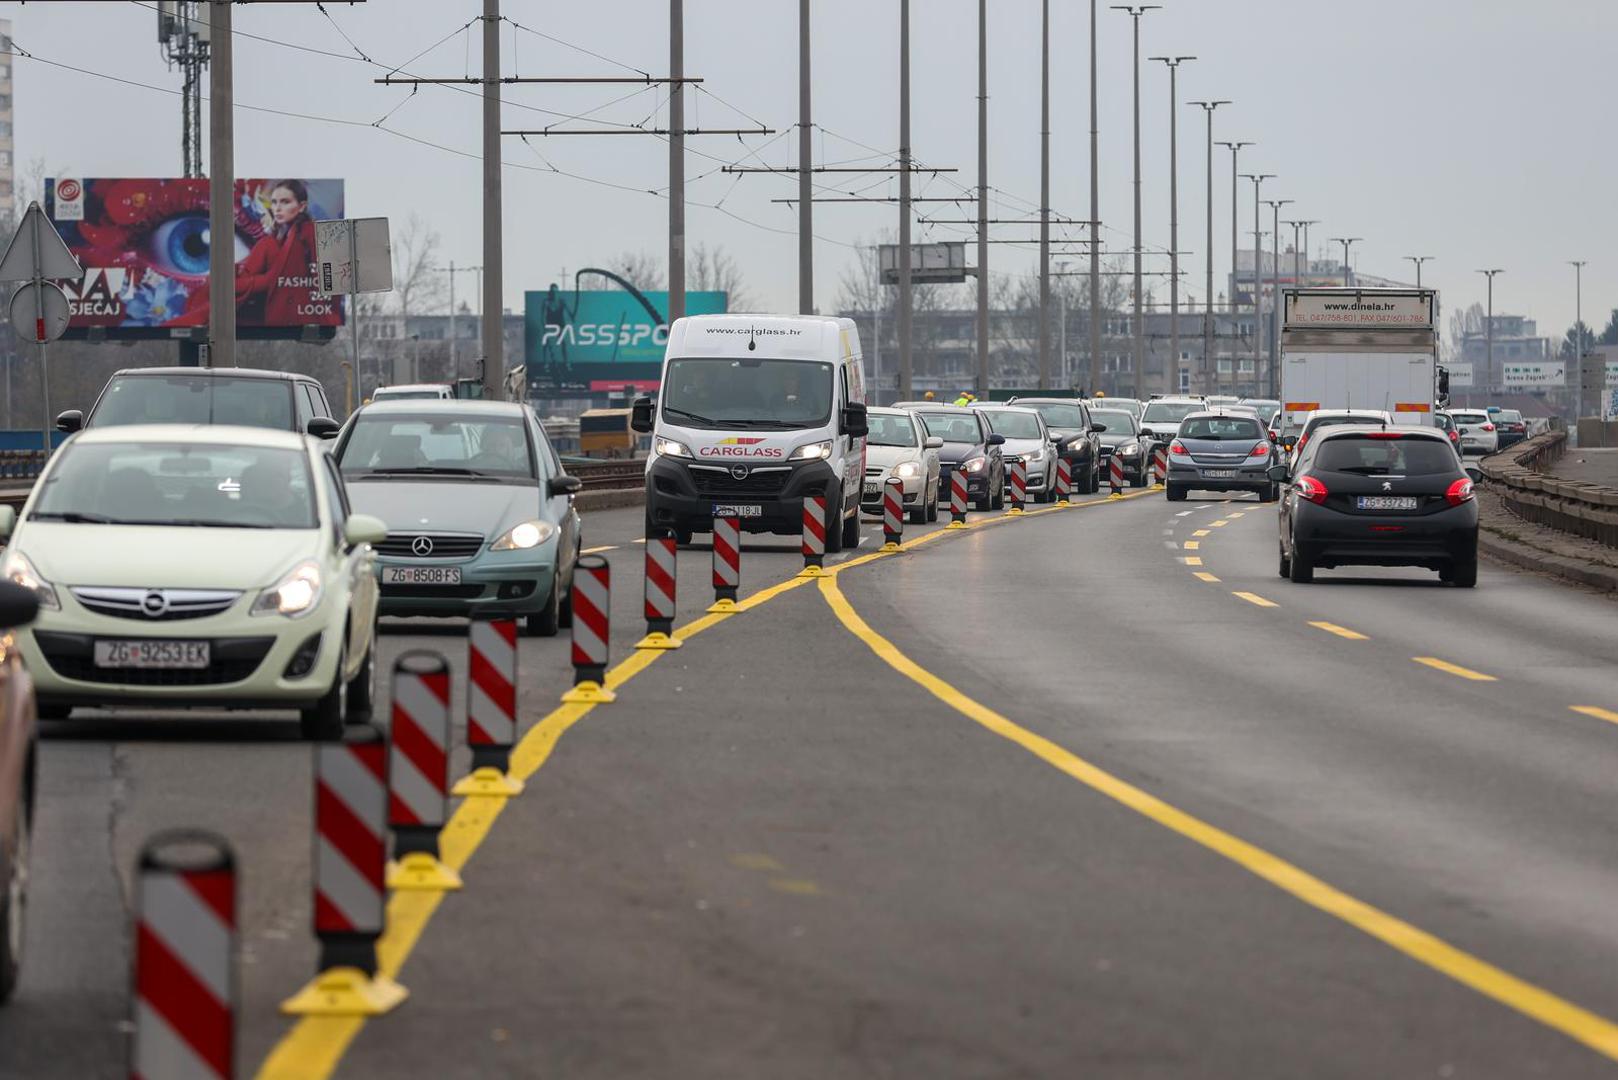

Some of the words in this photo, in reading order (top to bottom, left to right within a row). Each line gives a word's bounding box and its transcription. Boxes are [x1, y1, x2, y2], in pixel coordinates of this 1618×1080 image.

[277, 276, 319, 288] FASHIO
[70, 300, 121, 316] SJEĆAJ
[297, 303, 332, 315] LOOK
[1324, 302, 1396, 311] www.dinela.hr
[706, 327, 802, 336] www.carglass.hr
[700, 446, 782, 458] CARGLASS
